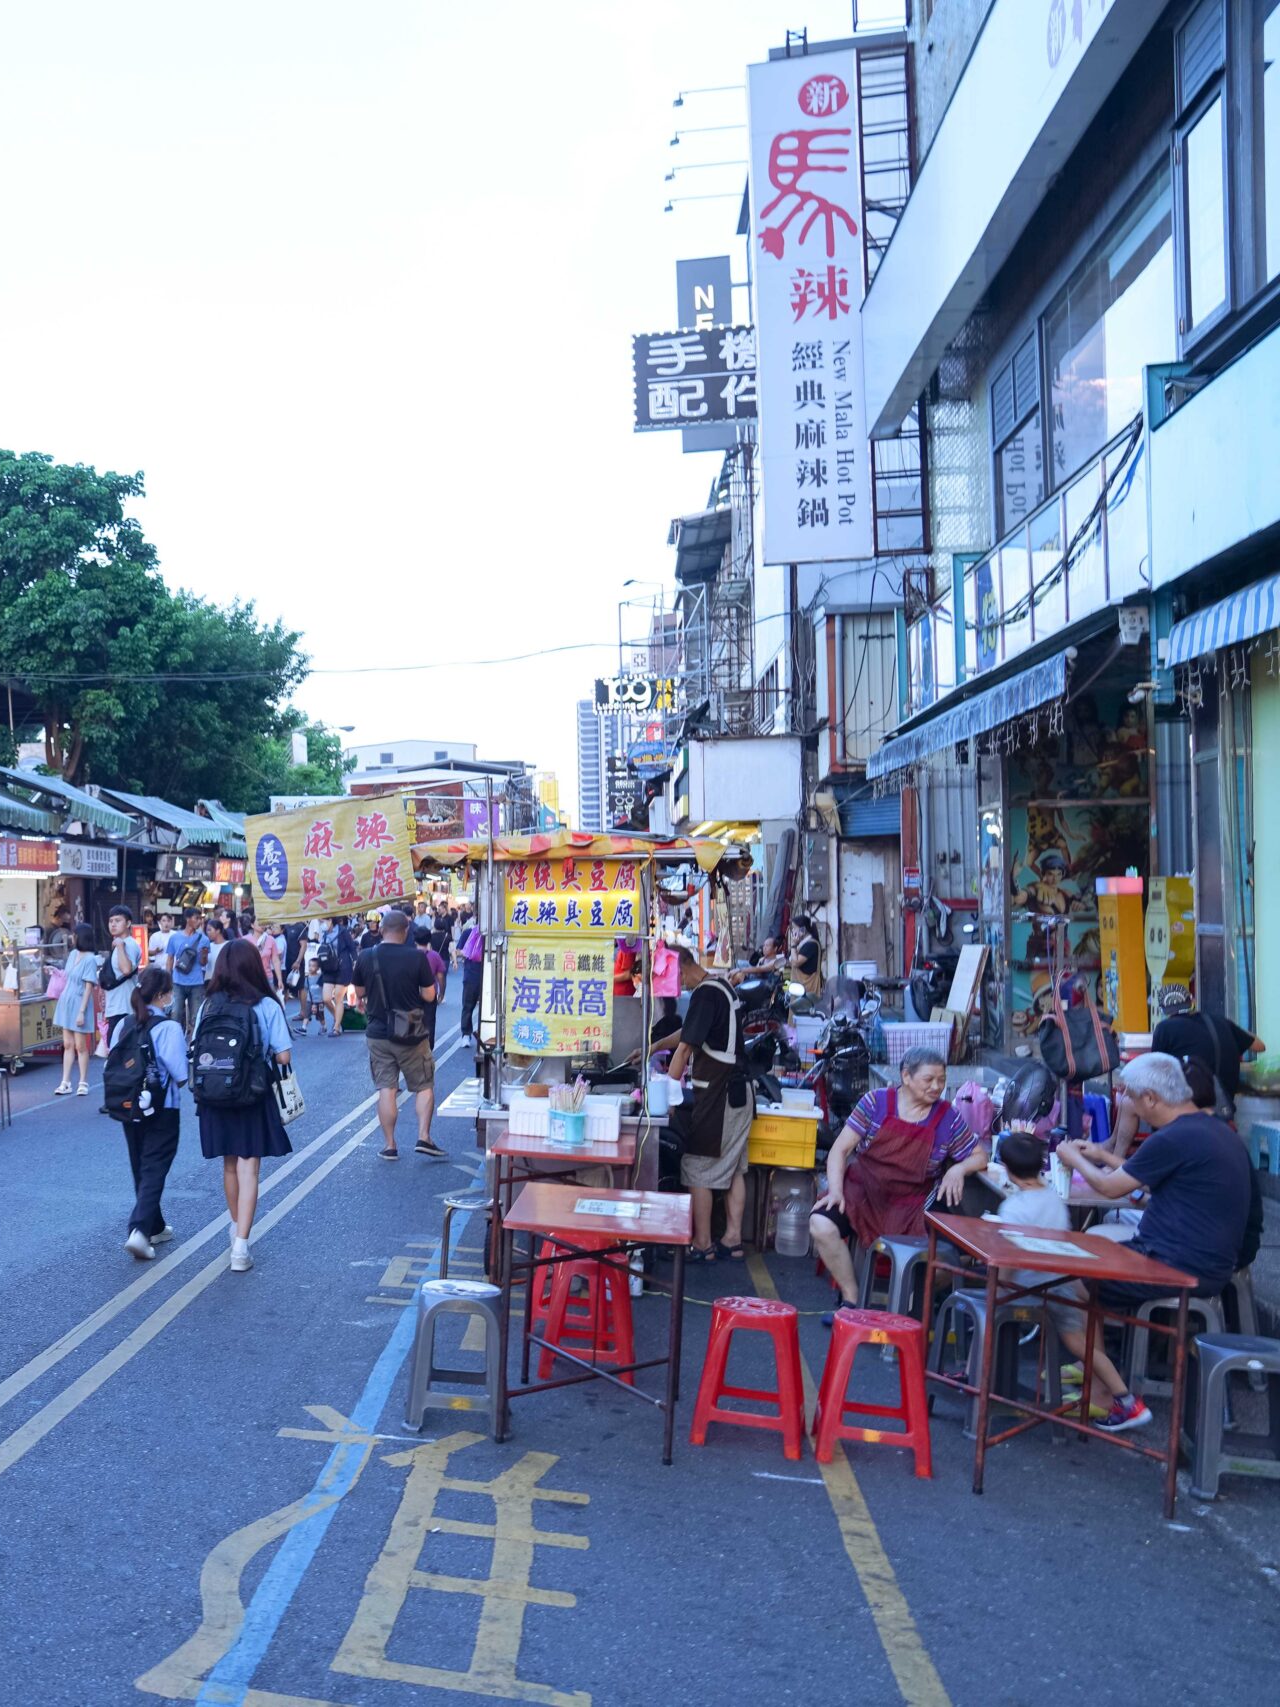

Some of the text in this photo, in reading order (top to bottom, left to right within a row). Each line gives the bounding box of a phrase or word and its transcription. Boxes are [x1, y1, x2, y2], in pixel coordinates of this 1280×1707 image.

[648, 375, 757, 419] 配件
[792, 340, 830, 529] 經典麻辣鍋
[832, 339, 856, 525] New Mala Hot Pot
[304, 812, 395, 859] 麻辣
[260, 839, 283, 891] 養生
[299, 855, 404, 910] 臭豆腐
[507, 859, 636, 892] 傳統臭豆腐
[511, 898, 634, 928] 麻辣臭豆腐
[514, 948, 606, 973] 低熱量 高纖維
[511, 976, 608, 1017] 海燕窩
[517, 1025, 545, 1044] 清涼
